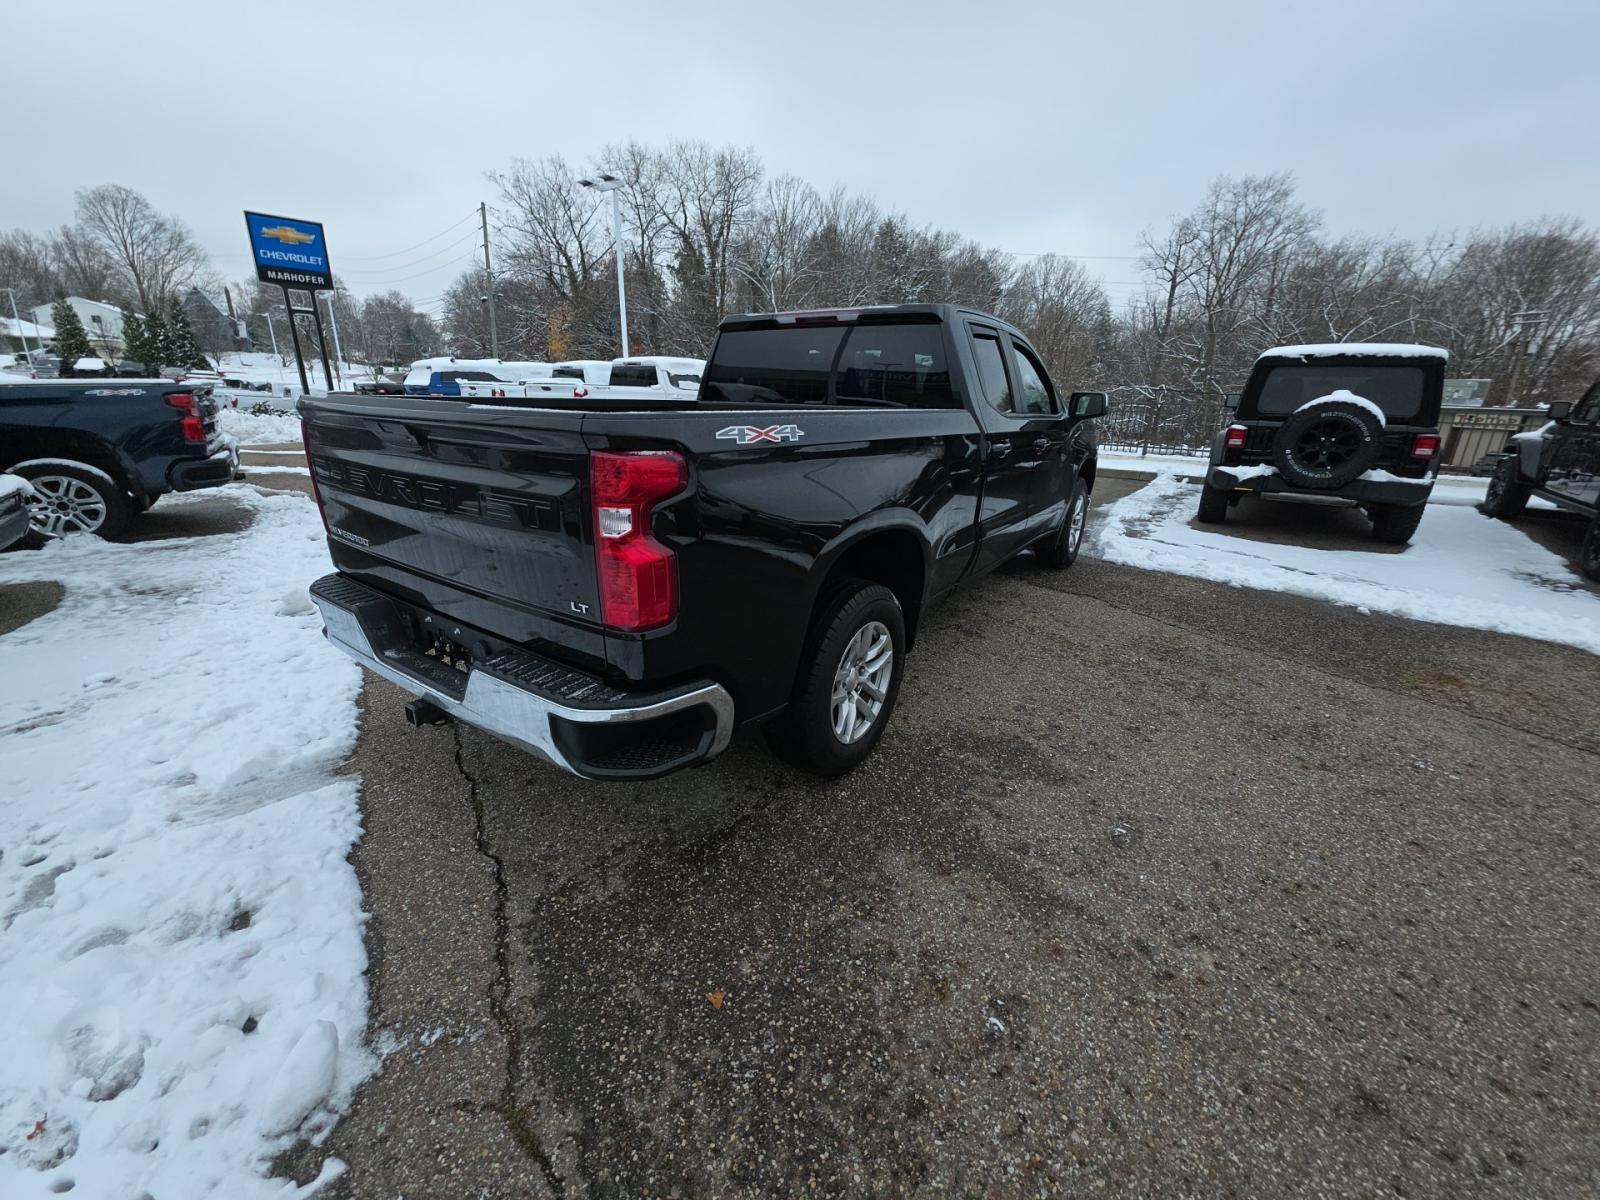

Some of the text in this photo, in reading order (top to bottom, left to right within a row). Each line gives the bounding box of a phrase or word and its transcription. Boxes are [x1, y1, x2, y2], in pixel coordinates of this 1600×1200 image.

[260, 249, 322, 265] CHEVROLET
[267, 270, 325, 285] MARHOFER
[570, 601, 589, 614] LT
